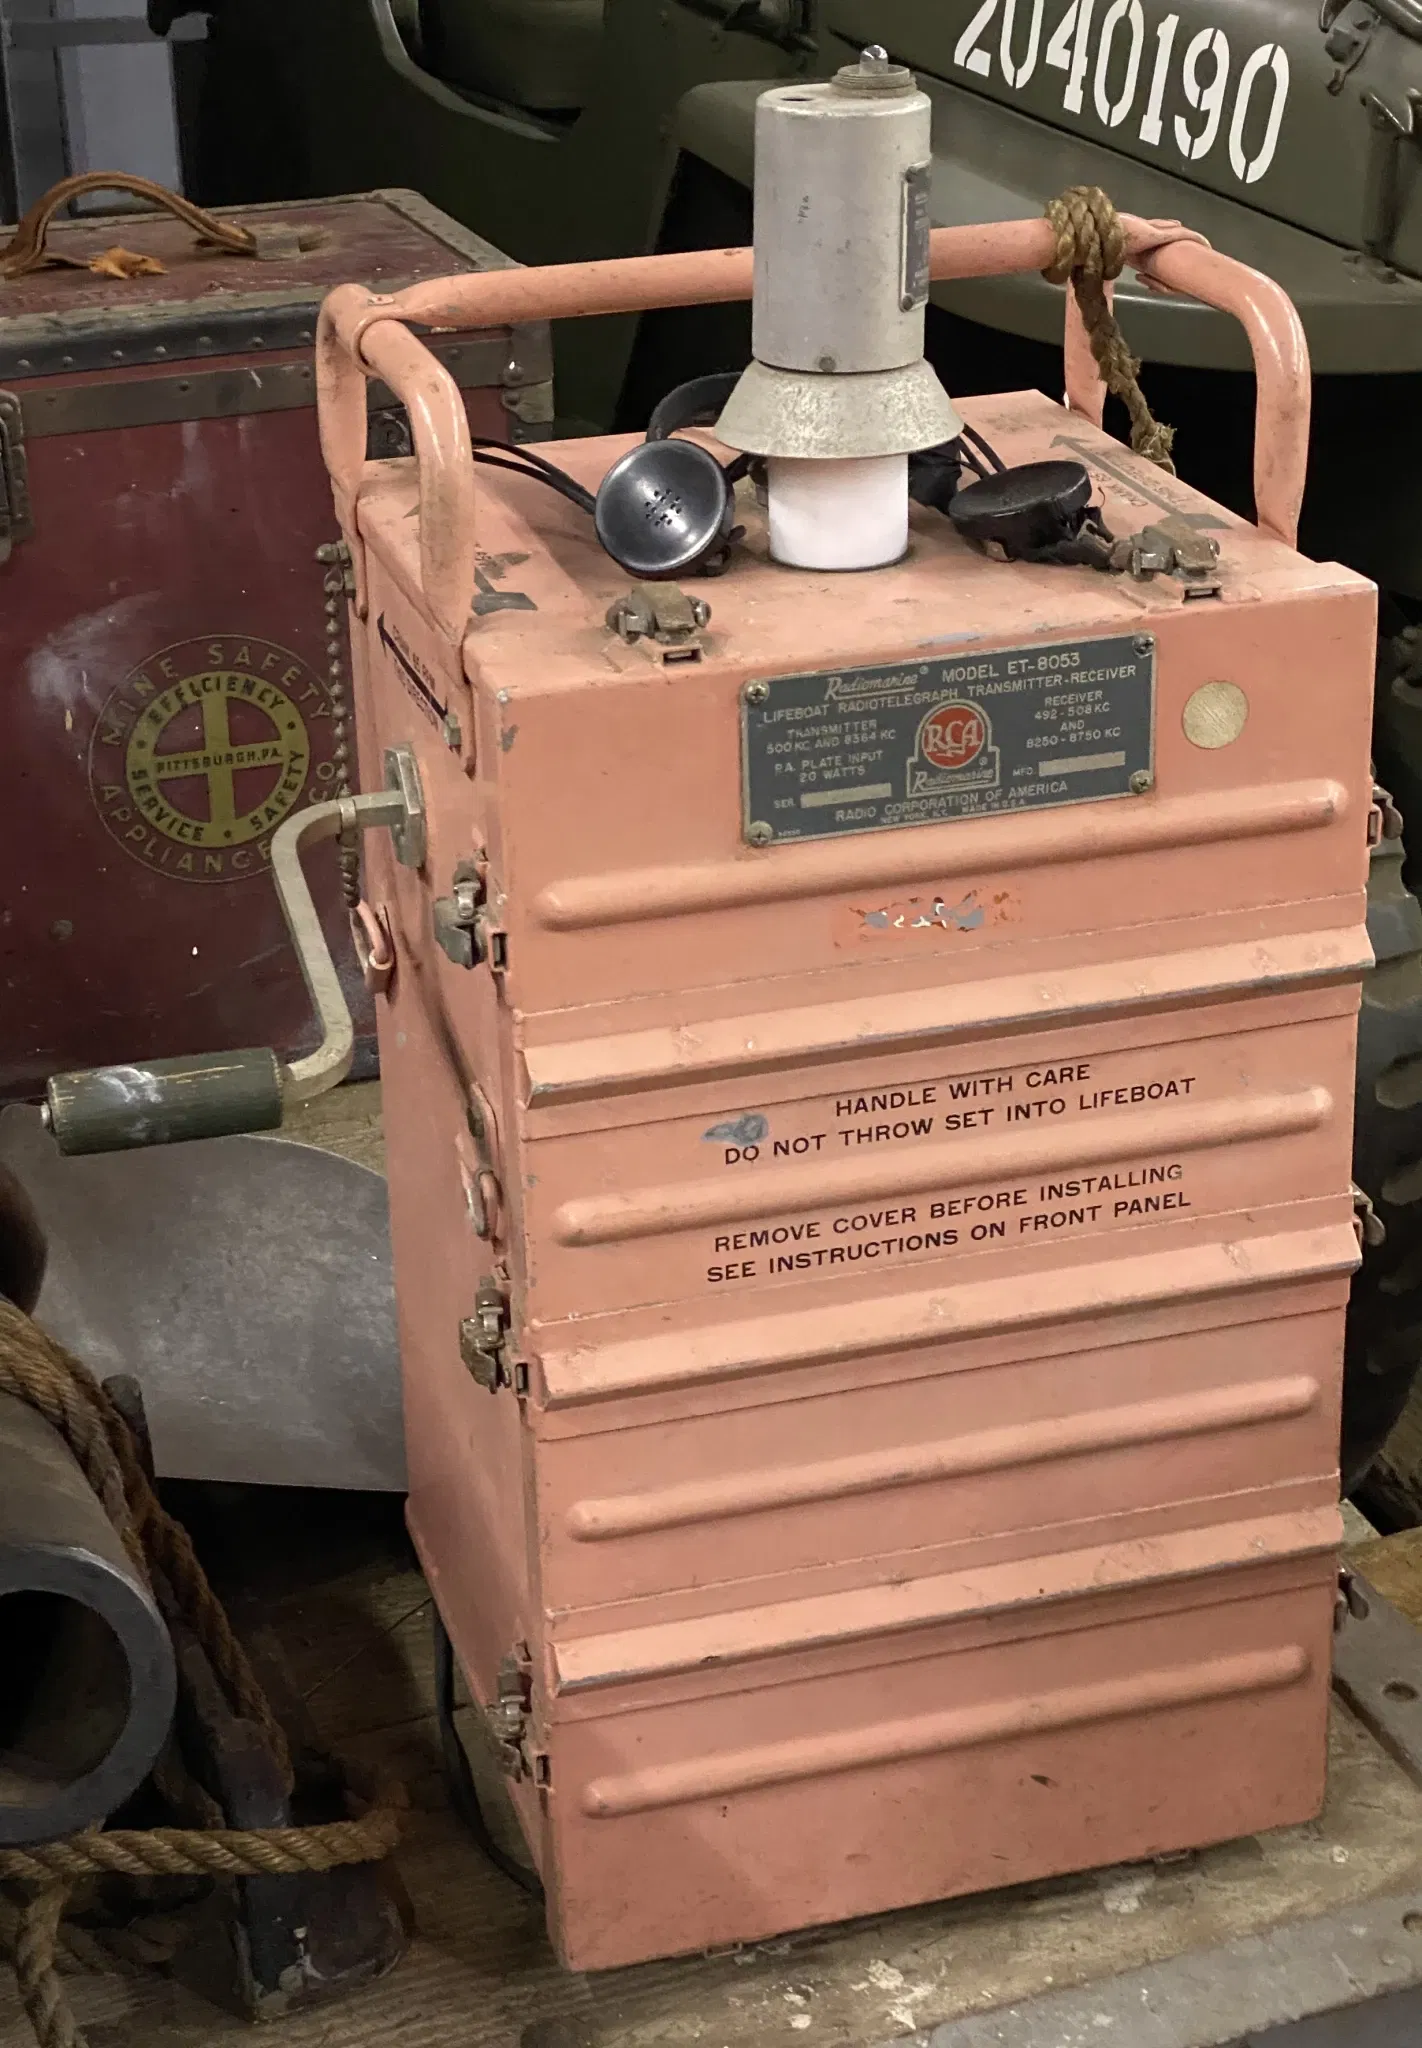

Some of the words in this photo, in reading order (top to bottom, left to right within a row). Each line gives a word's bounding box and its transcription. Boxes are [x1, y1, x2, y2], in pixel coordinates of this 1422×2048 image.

[954, 0, 1290, 184] 2040190
[942, 664, 999, 683] MODEL
[1007, 651, 1081, 675] ET-8053
[102, 656, 179, 746] MINE
[207, 643, 330, 720] SAFETY
[148, 675, 285, 726] EFFICIENCY
[763, 703, 830, 724] LIFEBOAT
[838, 687, 958, 714] RADIOTELEGRAPH
[967, 664, 1137, 698] TRANSMITTER-RECEIVER
[1044, 690, 1104, 707] RECEIVER
[1094, 701, 1111, 714] KC
[766, 743, 792, 755] 500
[794, 740, 811, 751] KC
[815, 737, 840, 749] AND
[880, 729, 897, 741] KC
[787, 718, 878, 740] TRANSMITTER
[924, 719, 982, 758] RCA
[1059, 719, 1085, 733] AND
[1104, 726, 1121, 738] KC
[800, 771, 817, 784] 20
[823, 765, 866, 781] WATTS
[801, 754, 843, 770] PLATE
[847, 749, 884, 764] INPUT
[131, 768, 204, 842] SERVICE
[249, 750, 305, 831] SAFETY
[835, 805, 877, 822] RADIO
[884, 791, 979, 817] CORPORATION
[985, 787, 1004, 801] OF
[1008, 780, 1069, 798] AMERICA
[101, 784, 273, 874] APPLIANCE
[835, 1086, 938, 1118] HANDLE
[948, 1075, 1014, 1100] WITH
[1025, 1063, 1091, 1088] CARE
[724, 1144, 760, 1165] DO
[773, 1133, 828, 1157] NOT
[838, 1117, 934, 1147] THROW
[944, 1107, 995, 1131] SET
[1006, 1097, 1067, 1122] INTO
[1078, 1076, 1196, 1111] LIFEBOAT
[714, 1221, 821, 1253] REMOVE
[831, 1206, 917, 1235] COVER
[930, 1188, 1028, 1219] BEFORE
[1039, 1163, 1183, 1202] INSTALLING
[706, 1260, 757, 1283] SEE
[768, 1228, 959, 1275] INSTRUCTIONS
[970, 1220, 1006, 1242] ON
[1019, 1204, 1103, 1234] FRONT
[1113, 1190, 1192, 1218] PANEL
